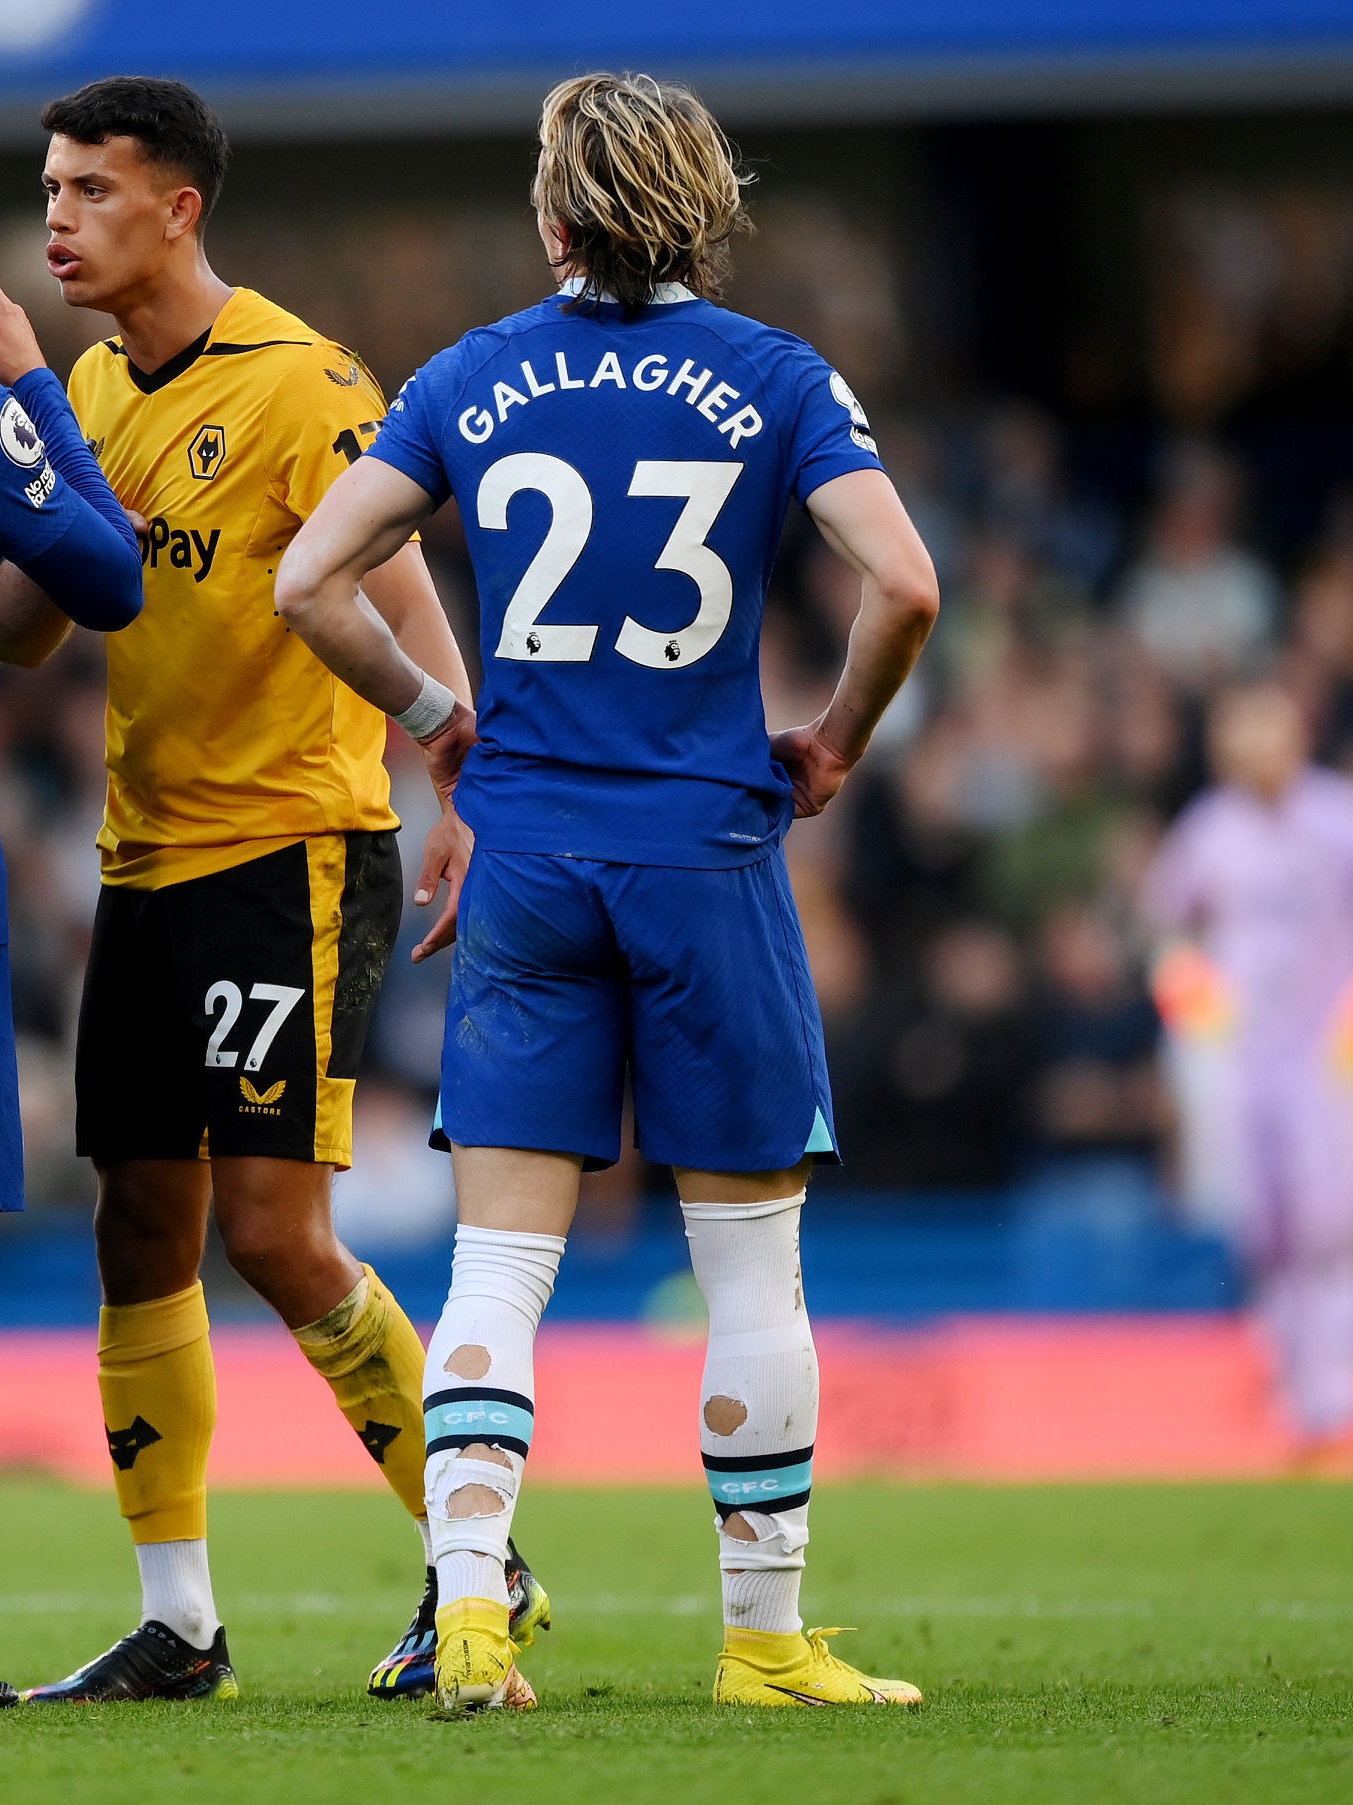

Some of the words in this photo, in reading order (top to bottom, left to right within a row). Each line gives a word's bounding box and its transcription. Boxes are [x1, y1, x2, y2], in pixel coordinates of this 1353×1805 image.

[457, 351, 763, 450] GALLAGHER
[24, 479, 42, 498] No
[476, 452, 745, 670] 23
[204, 980, 306, 1072] 27
[238, 1105, 282, 1116] CASTORE
[442, 1411, 510, 1426] CFC
[721, 1478, 779, 1495] CFC
